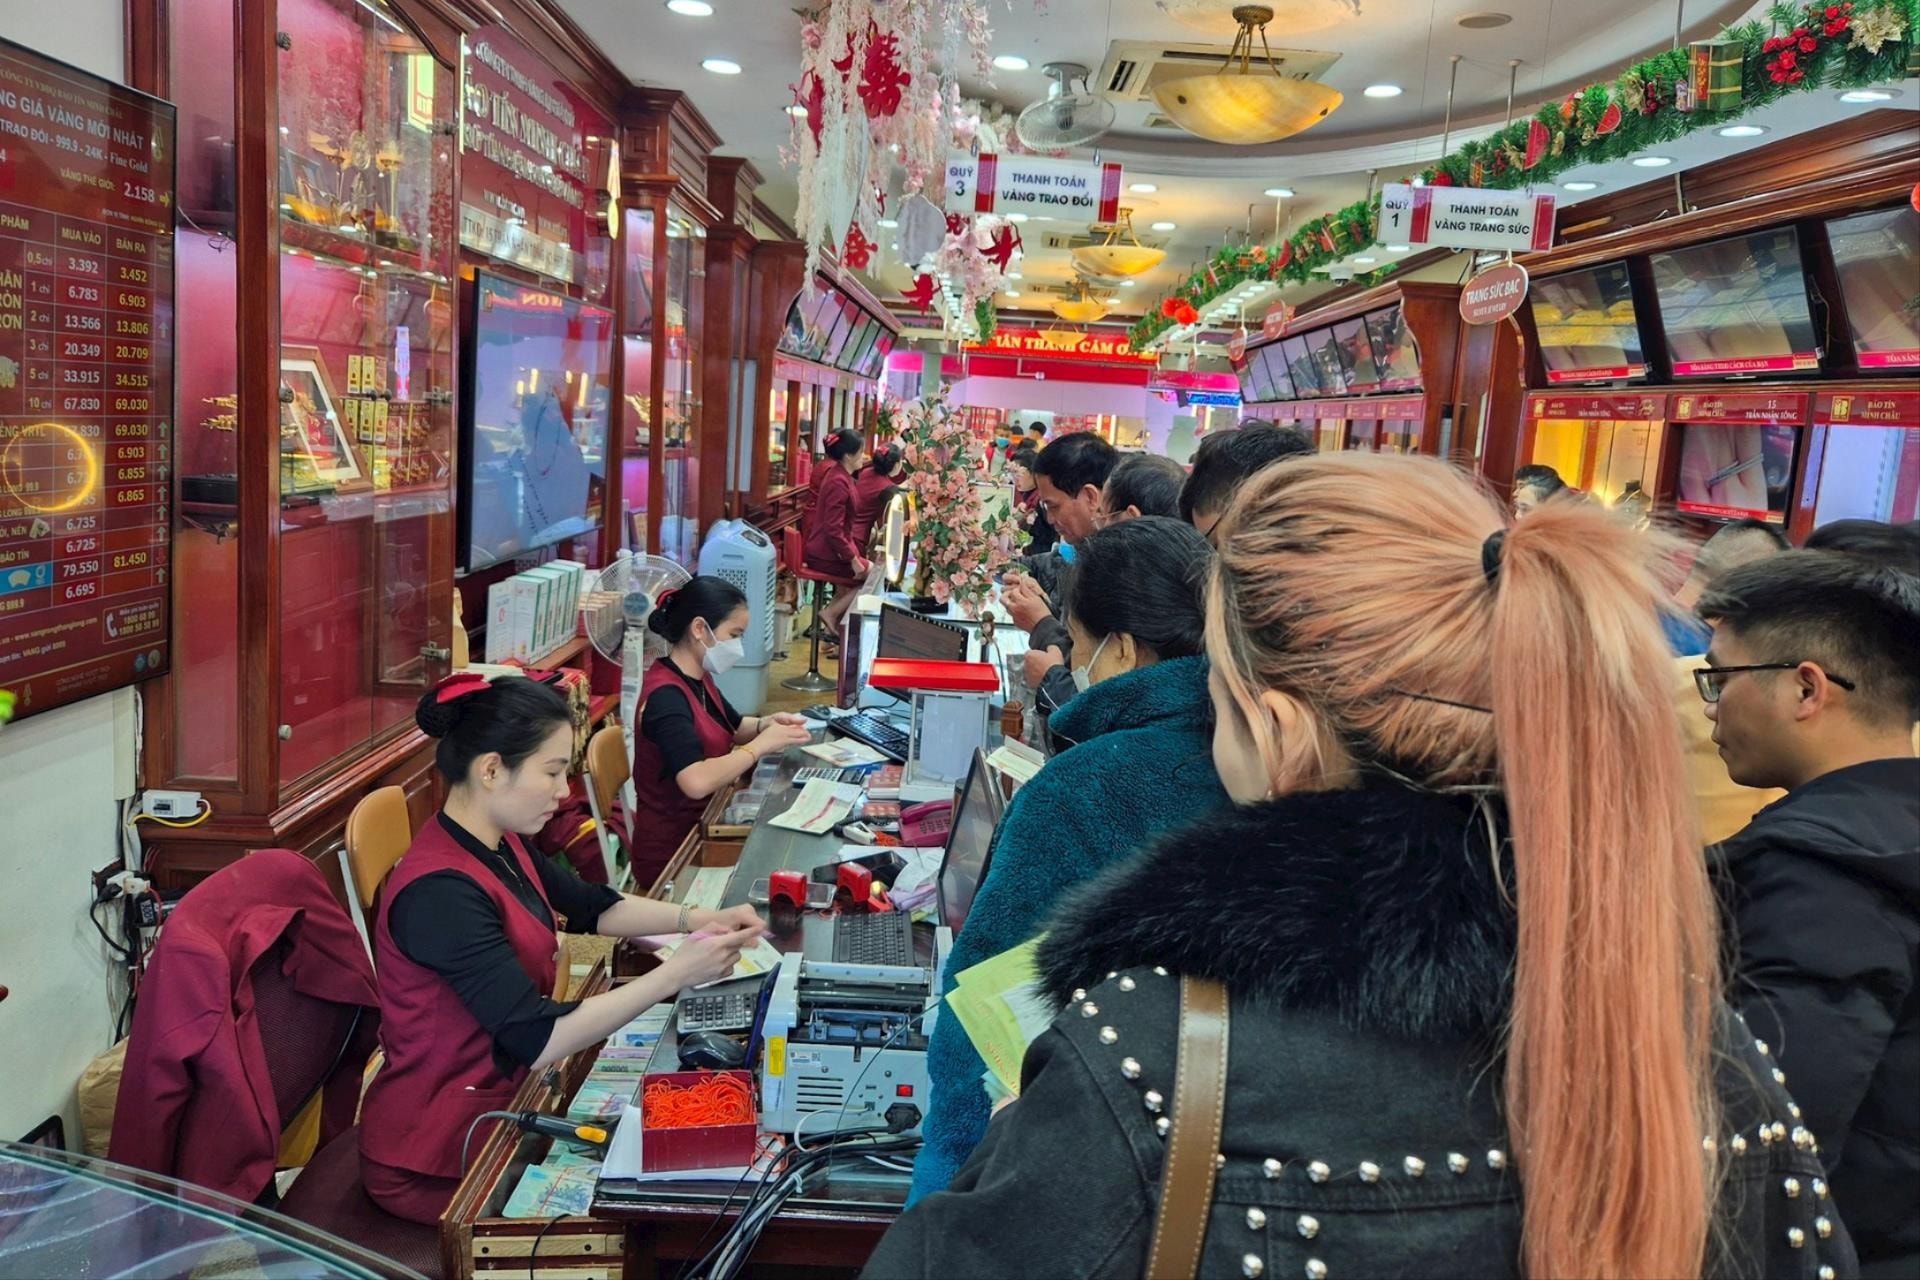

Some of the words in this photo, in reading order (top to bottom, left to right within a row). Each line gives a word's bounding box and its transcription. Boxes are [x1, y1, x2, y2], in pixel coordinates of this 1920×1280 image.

[20, 96, 45, 119] GIÁ
[47, 104, 84, 131] VÀNG
[0, 118, 28, 138] TRAO
[110, 152, 128, 168] Fine
[128, 158, 148, 173] Gold
[950, 165, 974, 178] QUỸ
[1012, 172, 1050, 185] THANH
[1054, 174, 1087, 188] TOÁN
[124, 182, 155, 203] 2.158
[954, 180, 966, 197] 3
[1002, 188, 1036, 203] VÀNG
[1039, 192, 1069, 206] TRAO
[1072, 191, 1094, 207] ĐỔI
[1385, 199, 1409, 211] QUỸ
[1450, 203, 1486, 216] THANH
[1489, 203, 1520, 217] TOÁN
[1391, 212, 1399, 228] 1
[1435, 217, 1466, 231] VÀNG
[1469, 221, 1505, 234] TRANG
[1508, 220, 1531, 235] SỨC
[61, 227, 82, 242] MUA
[82, 231, 101, 245] VÀO
[134, 243, 146, 254] RA
[68, 257, 99, 274] 3.392
[120, 267, 147, 282] 3.452
[31, 280, 36, 293] 1
[68, 286, 98, 301] 6.783
[1466, 285, 1490, 306] TRANG
[1489, 280, 1505, 300] SỨC
[1504, 278, 1521, 299] BẠC
[119, 293, 146, 308] 6.903
[30, 310, 37, 322] 2
[65, 315, 101, 331] 13.566
[116, 320, 149, 335] 13.806
[30, 338, 36, 351] 3
[65, 342, 100, 356] 20.349
[116, 346, 149, 359] 20.709
[30, 367, 36, 380] 5
[64, 370, 100, 383] 33.915
[115, 374, 149, 387] 34.515
[29, 396, 39, 408] 10
[64, 397, 100, 410] 67.830
[115, 398, 148, 411] 69.030
[1767, 399, 1777, 409] 15
[115, 424, 148, 436] 69.030
[67, 448, 97, 461] 6.7
[118, 446, 145, 459] 6.903
[67, 472, 97, 485] 6.7
[118, 467, 145, 480] 6.855
[118, 489, 145, 502] 6.865
[66, 516, 96, 530] 6.735
[66, 538, 96, 553] 6.725
[113, 552, 147, 568] 81.450
[63, 559, 99, 577] 79.550
[65, 582, 95, 599] 6.695
